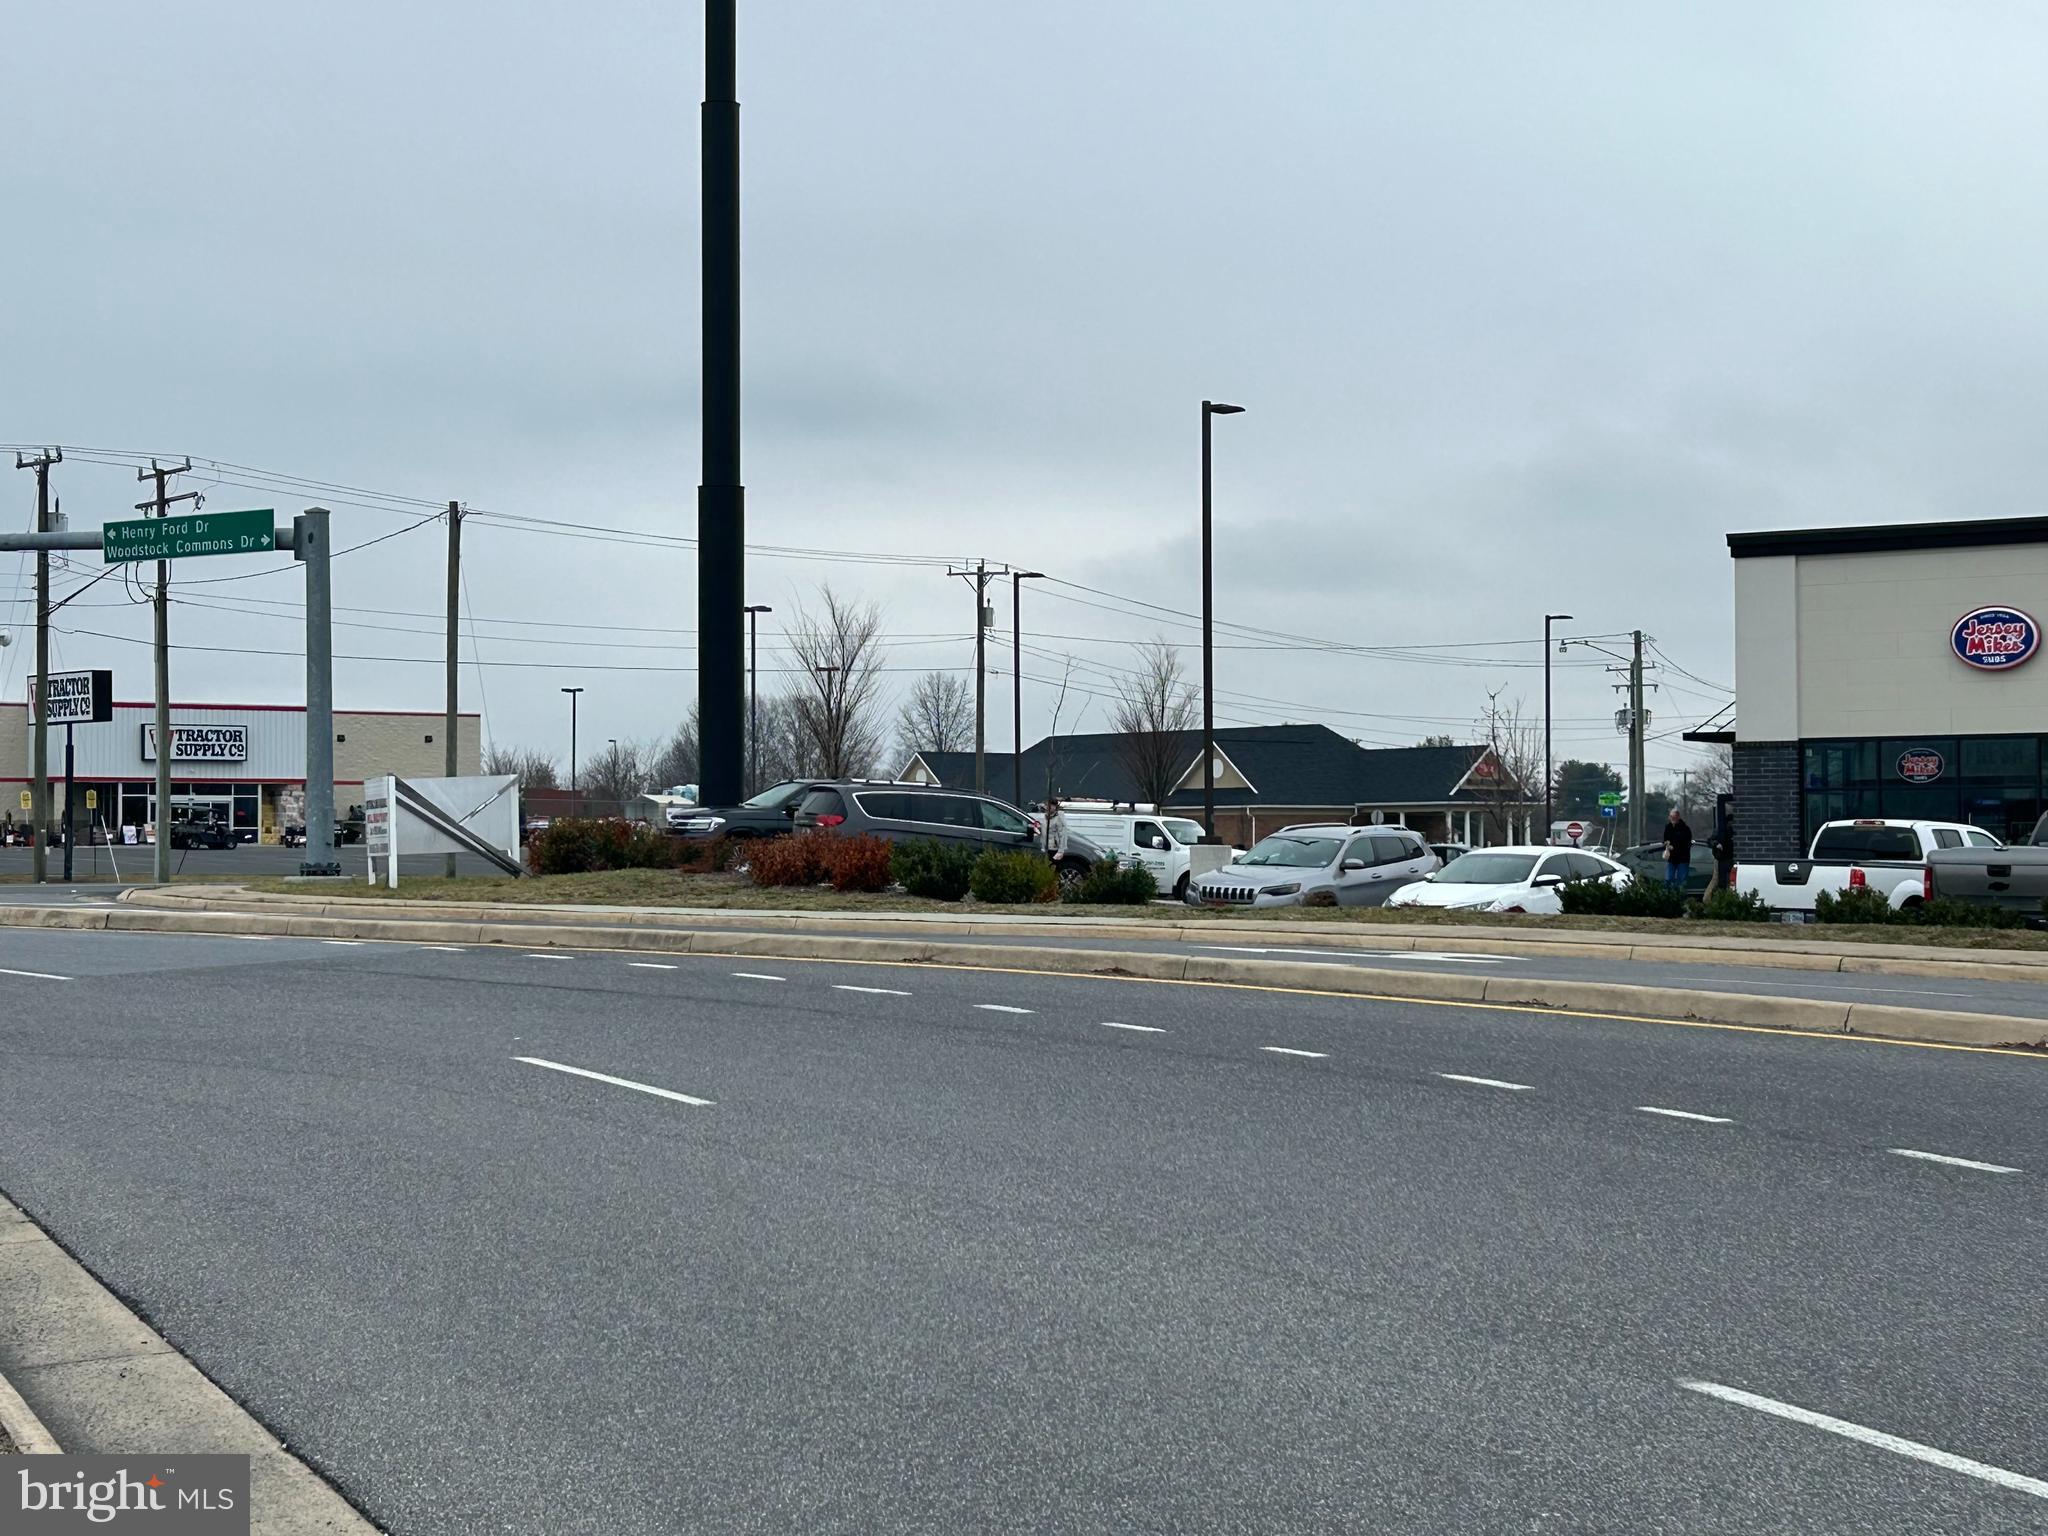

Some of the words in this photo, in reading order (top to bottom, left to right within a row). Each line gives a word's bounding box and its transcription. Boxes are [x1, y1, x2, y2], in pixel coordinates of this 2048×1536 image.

[122, 526, 155, 541] Henry
[162, 522, 188, 536] Ford
[195, 520, 209, 533] Dr
[107, 543, 169, 558] Woodstock
[176, 539, 233, 553] Commons
[240, 535, 255, 548] Dr
[1962, 619, 2026, 641] Jersey
[47, 677, 90, 698] TRACTOR
[47, 697, 79, 718] SUPPLY
[175, 729, 244, 743] TRACTOR
[175, 743, 227, 757] SUPPLY
